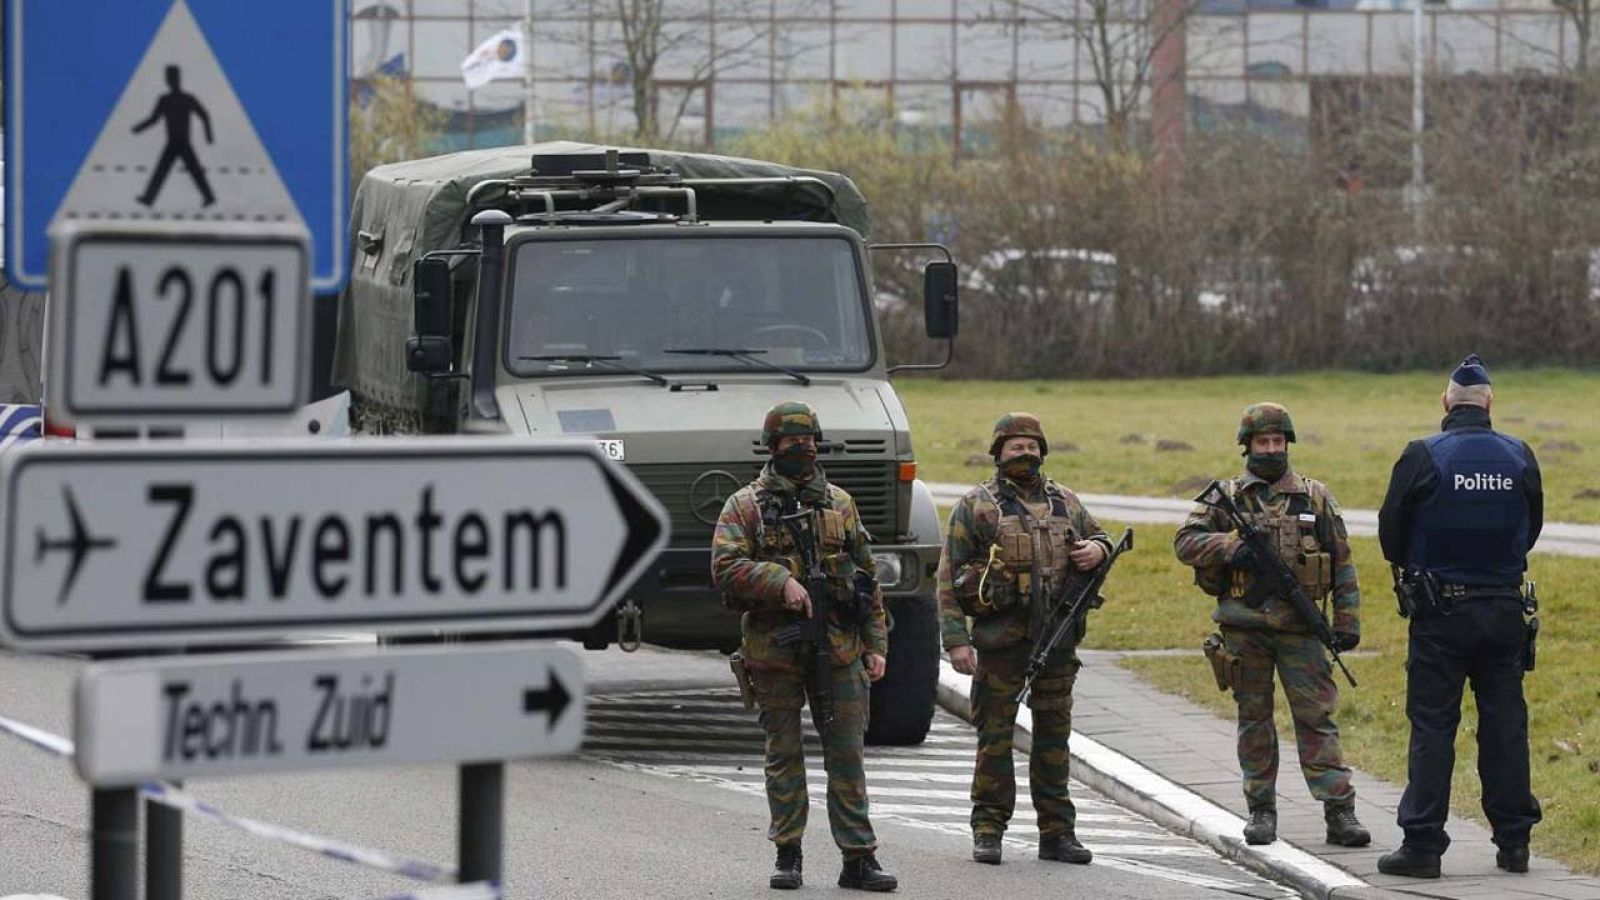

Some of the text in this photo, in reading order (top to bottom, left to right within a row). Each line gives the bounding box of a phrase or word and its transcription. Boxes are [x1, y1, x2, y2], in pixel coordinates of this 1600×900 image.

[99, 263, 277, 388] A201
[1454, 472, 1513, 491] Politie
[142, 484, 568, 603] Zaventem
[163, 673, 394, 763] Techn. Zuid
